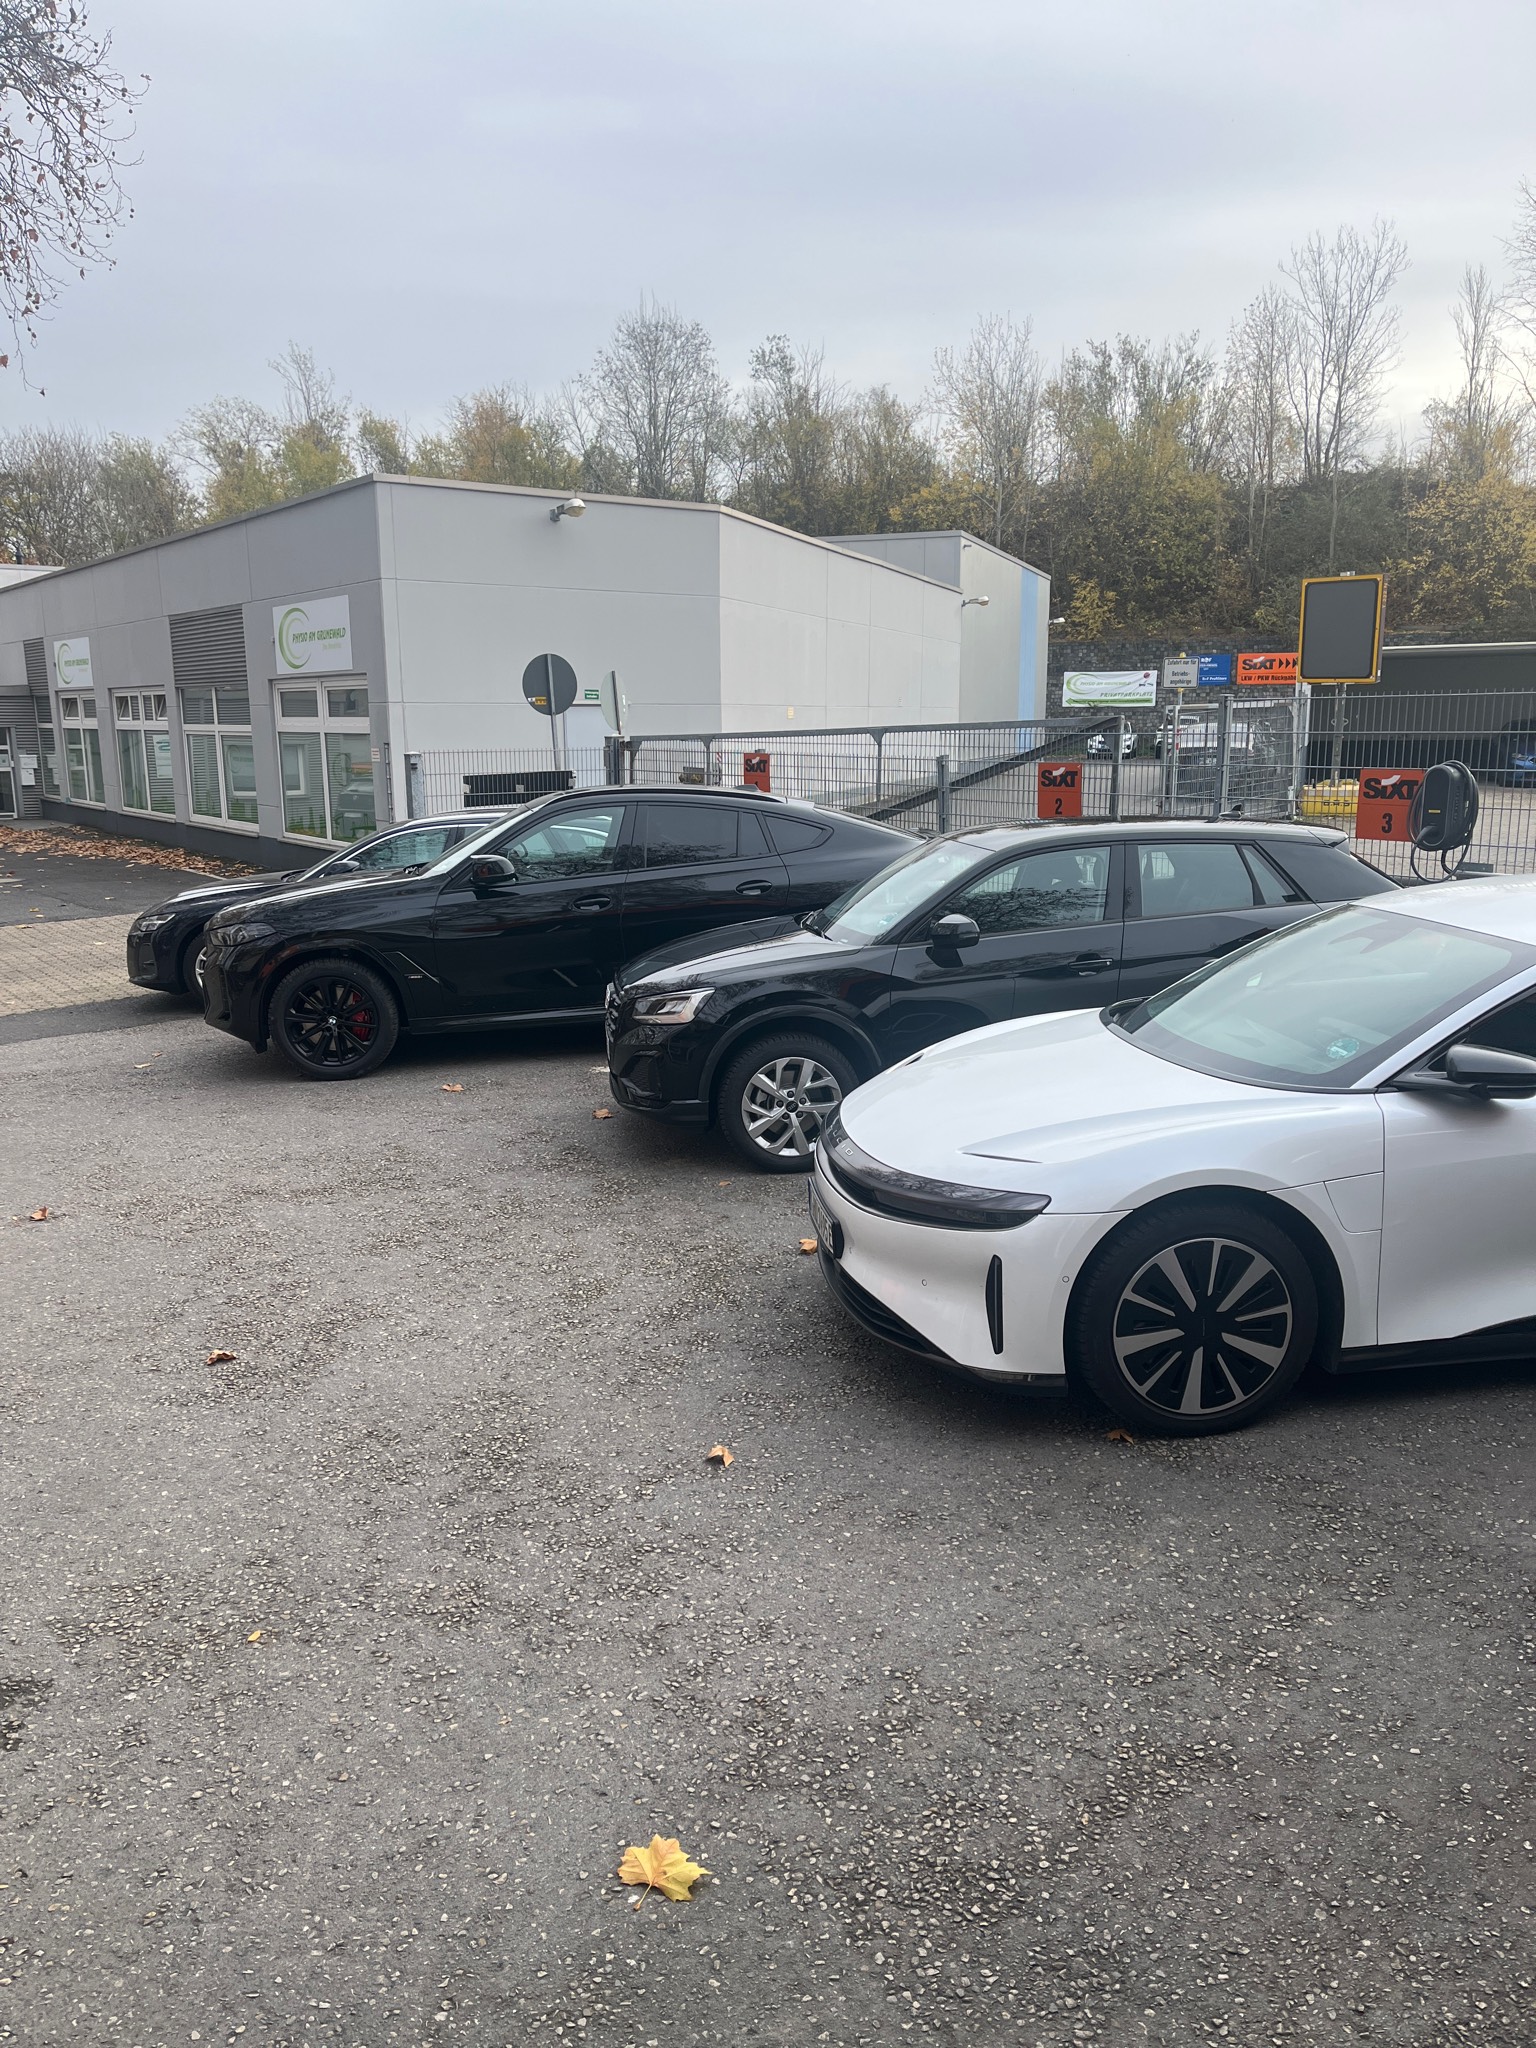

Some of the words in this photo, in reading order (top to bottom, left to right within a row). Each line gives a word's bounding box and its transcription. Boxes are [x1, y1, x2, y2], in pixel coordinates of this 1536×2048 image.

[292, 631, 308, 644] PHYSIO
[1242, 656, 1277, 671] SIXT
[745, 756, 768, 773] SIXT
[1041, 767, 1078, 787] SIXT
[1363, 775, 1419, 800] SIXT
[1055, 798, 1063, 815] 2
[1381, 812, 1393, 834] 3
